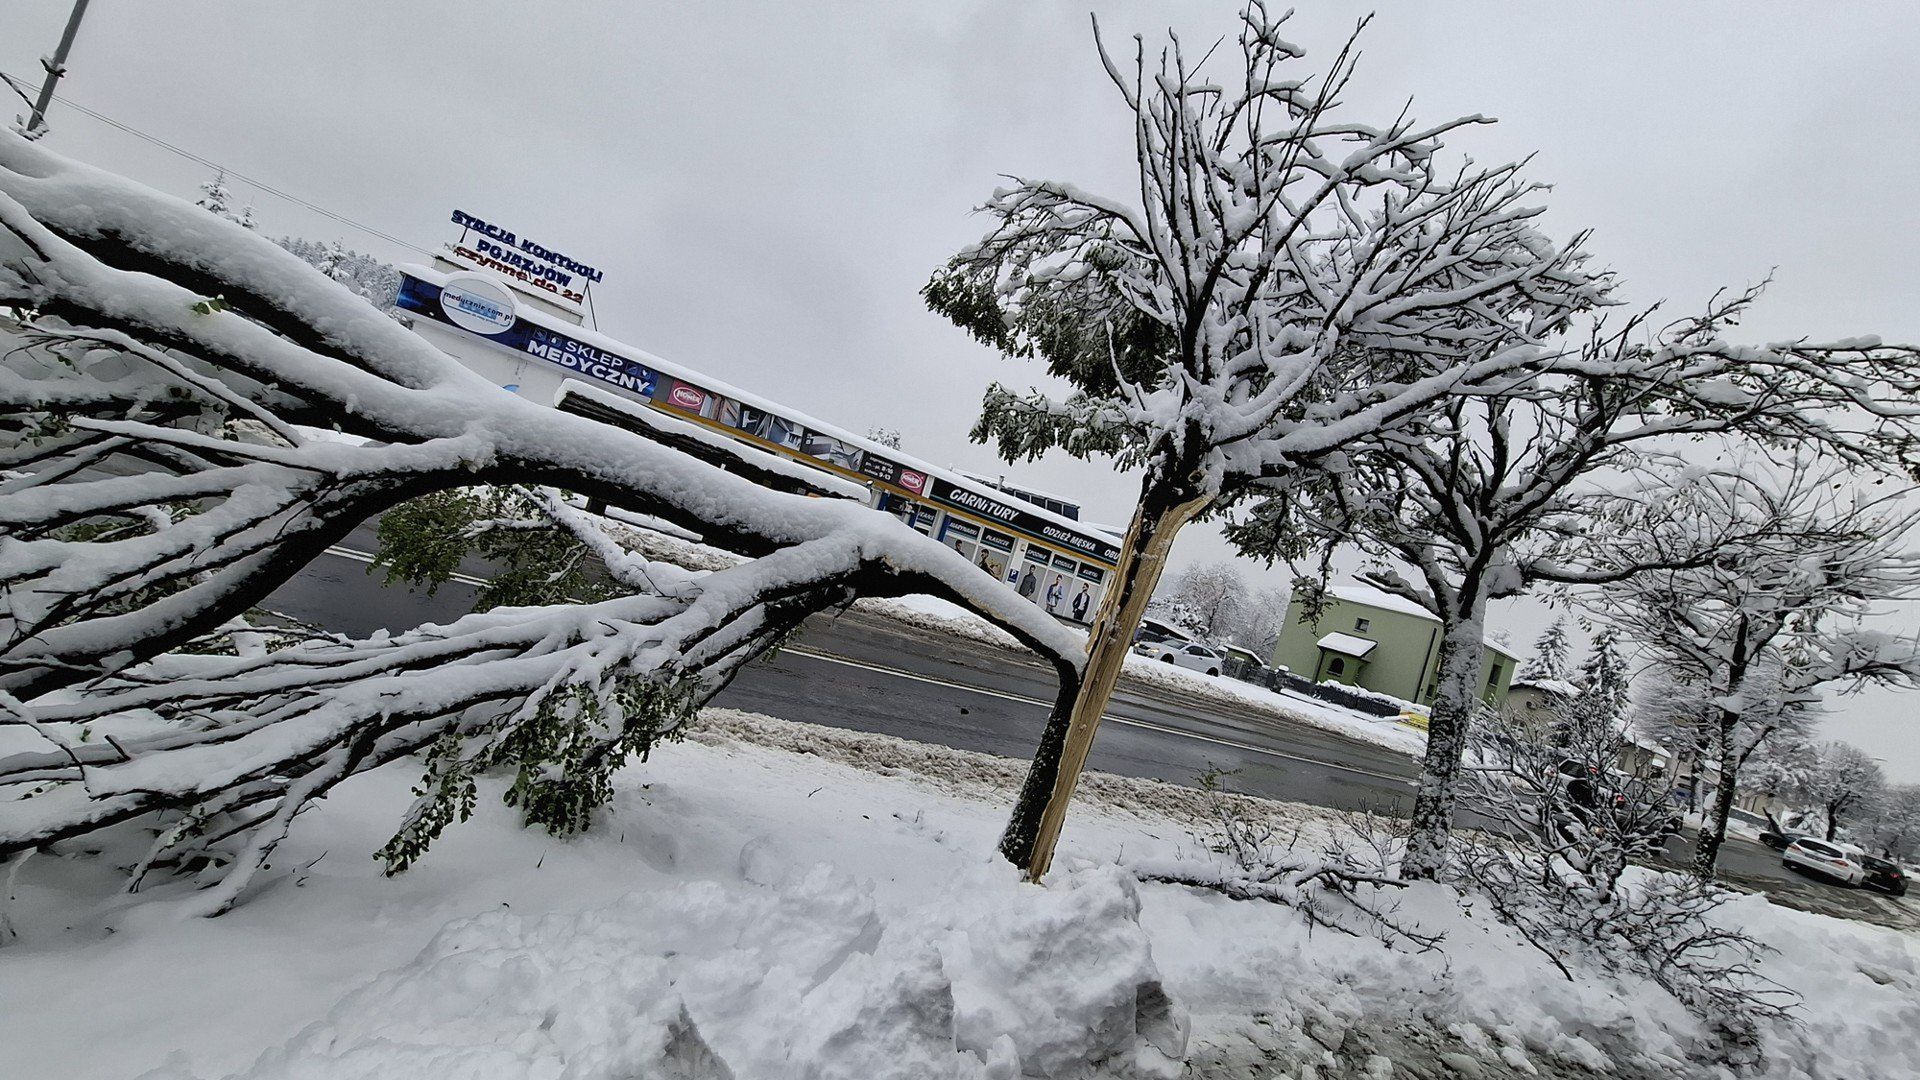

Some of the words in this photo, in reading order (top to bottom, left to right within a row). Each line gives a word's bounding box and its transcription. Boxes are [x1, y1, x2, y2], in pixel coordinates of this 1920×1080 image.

[451, 209, 517, 248] STACJA
[521, 239, 604, 284] KONTROLI
[476, 238, 572, 288] POJAZDÓW
[453, 246, 529, 281] czynne
[533, 277, 558, 294] do
[561, 288, 584, 306] 22
[526, 339, 651, 393] MEDYCZNY
[565, 340, 624, 368] SKLEP
[1069, 535, 1097, 552] MĘSKA
